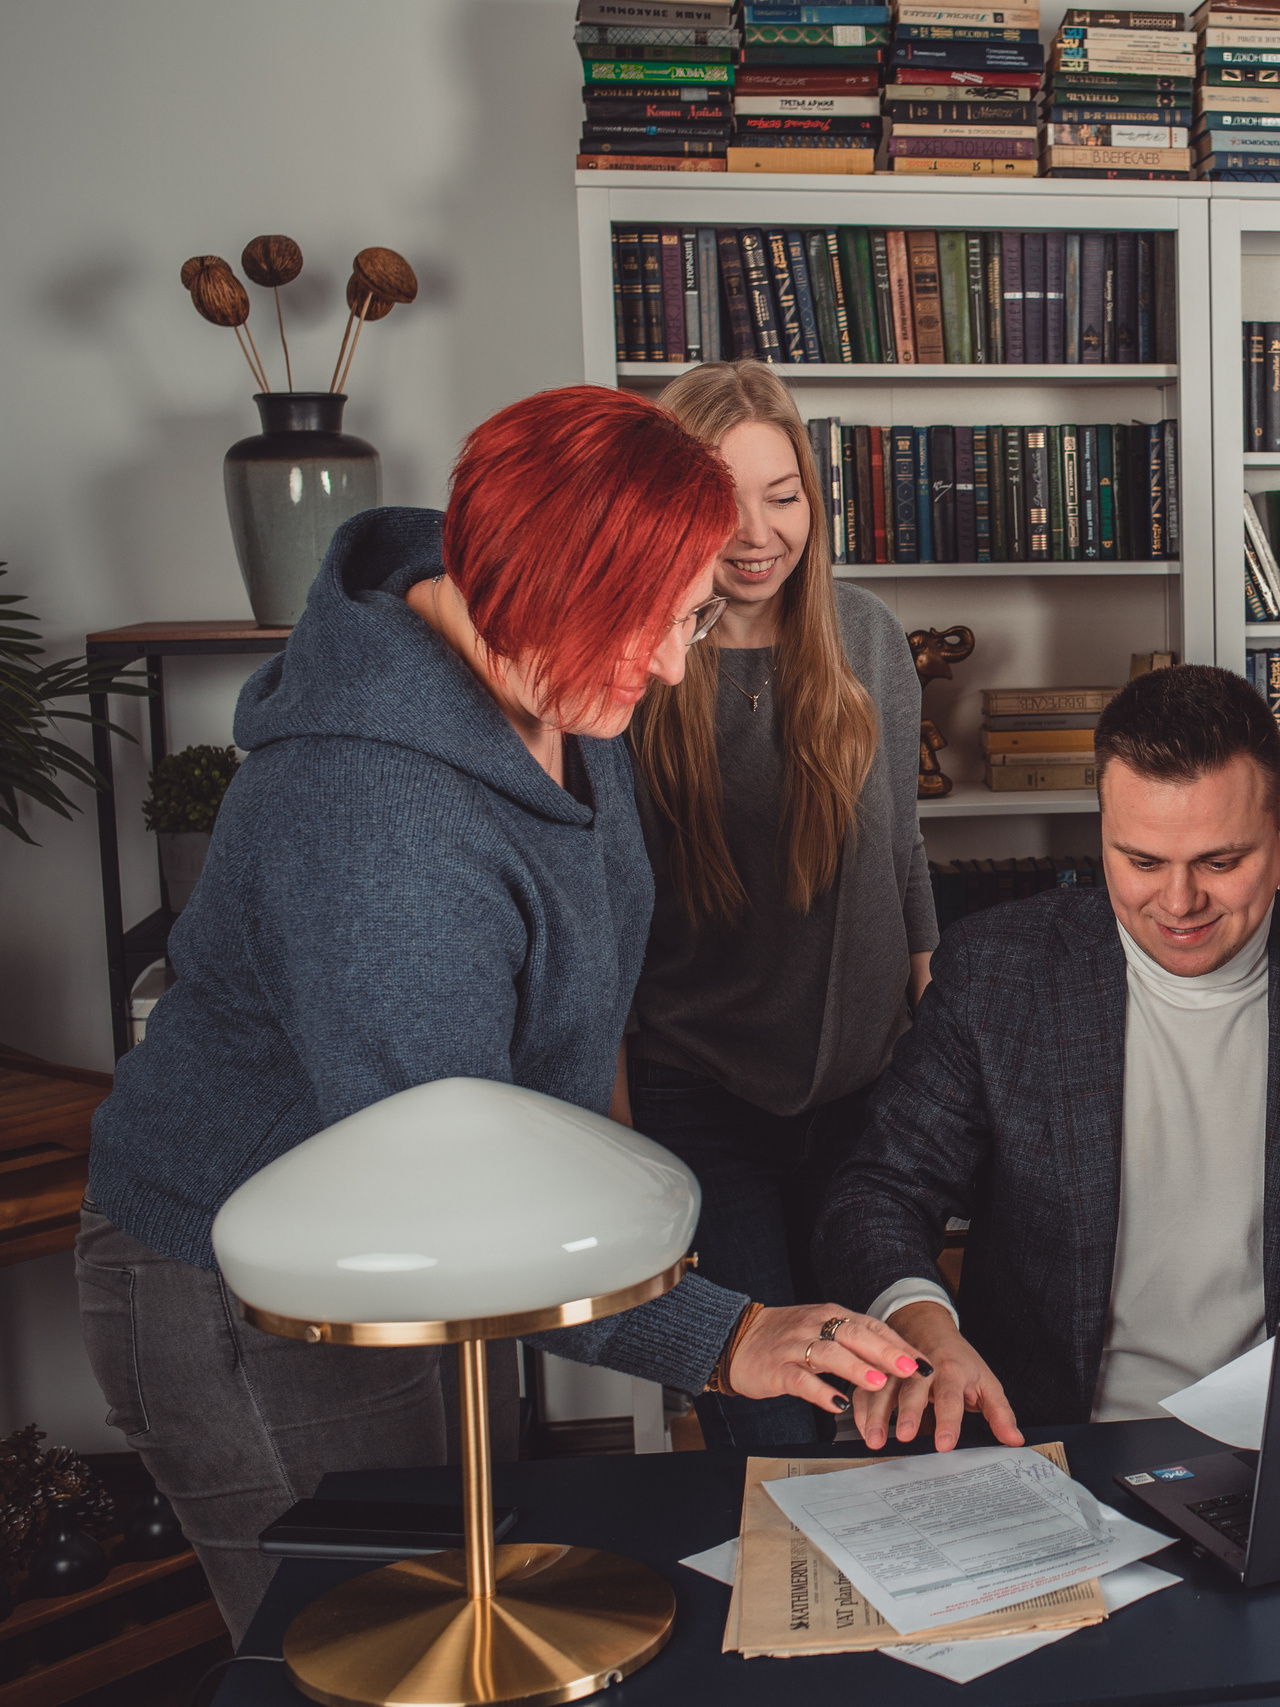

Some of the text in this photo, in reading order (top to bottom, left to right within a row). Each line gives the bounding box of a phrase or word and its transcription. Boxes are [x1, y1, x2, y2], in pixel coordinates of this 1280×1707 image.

[599, 6, 711, 20] НАШИ ЗНАКОМЫЕ
[1067, 93, 1119, 104] СТЕНДАЛЬ
[910, 140, 1015, 156] ДЖЕК ЛОНДОН
[790, 1559, 810, 1622] KATHIMERINI
[833, 1585, 859, 1607] plan
[835, 1608, 855, 1630] VAT
